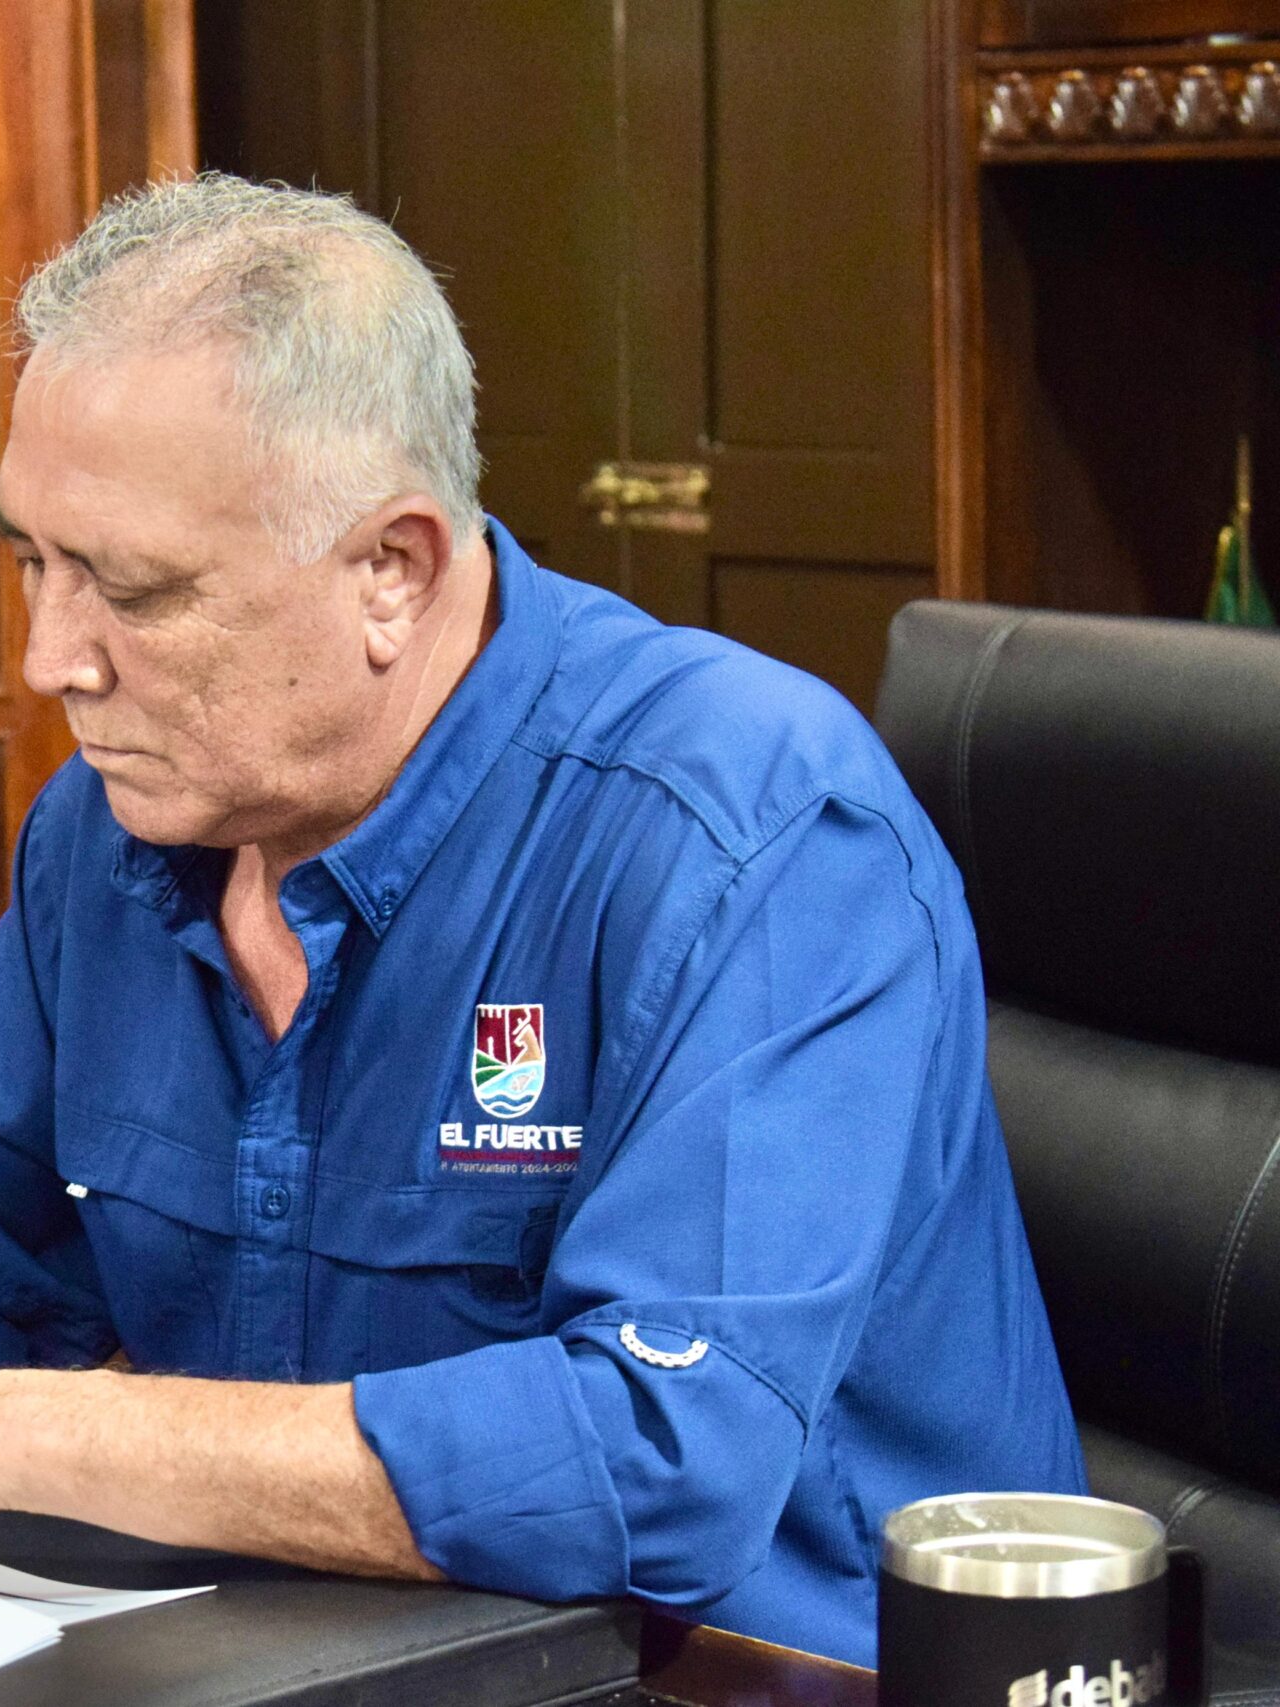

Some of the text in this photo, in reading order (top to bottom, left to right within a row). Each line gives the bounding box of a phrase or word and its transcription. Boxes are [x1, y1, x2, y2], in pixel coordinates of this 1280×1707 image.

[440, 1122, 583, 1150] EL FUERTE
[521, 1162, 579, 1174] 2024-202
